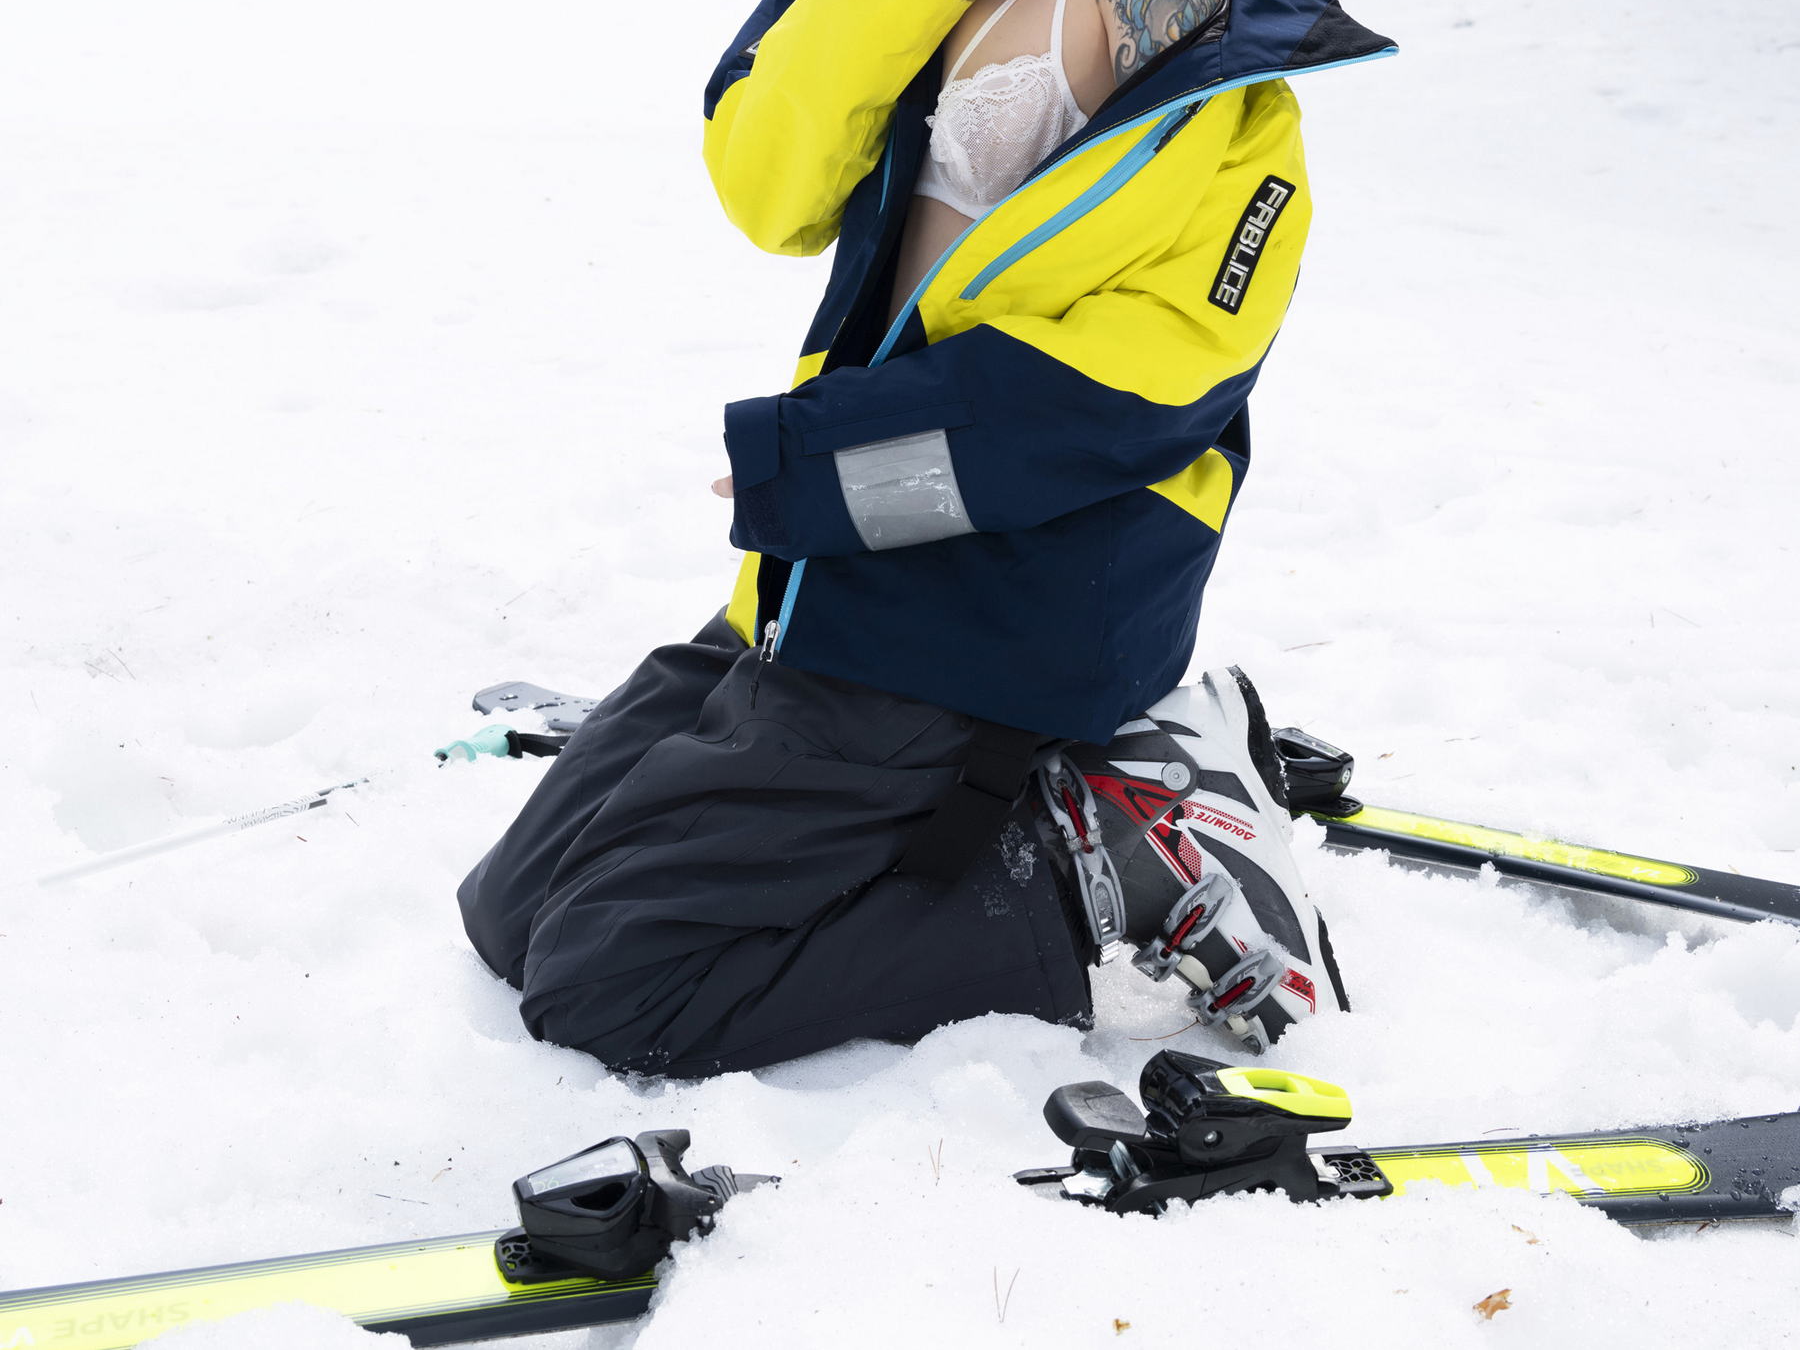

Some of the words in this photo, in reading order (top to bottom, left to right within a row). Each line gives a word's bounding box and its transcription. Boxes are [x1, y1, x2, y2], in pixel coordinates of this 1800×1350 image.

[1215, 181, 1289, 307] FABLICE
[1194, 811, 1257, 841] DOLOMITE
[52, 1301, 190, 1339] SHAPE
